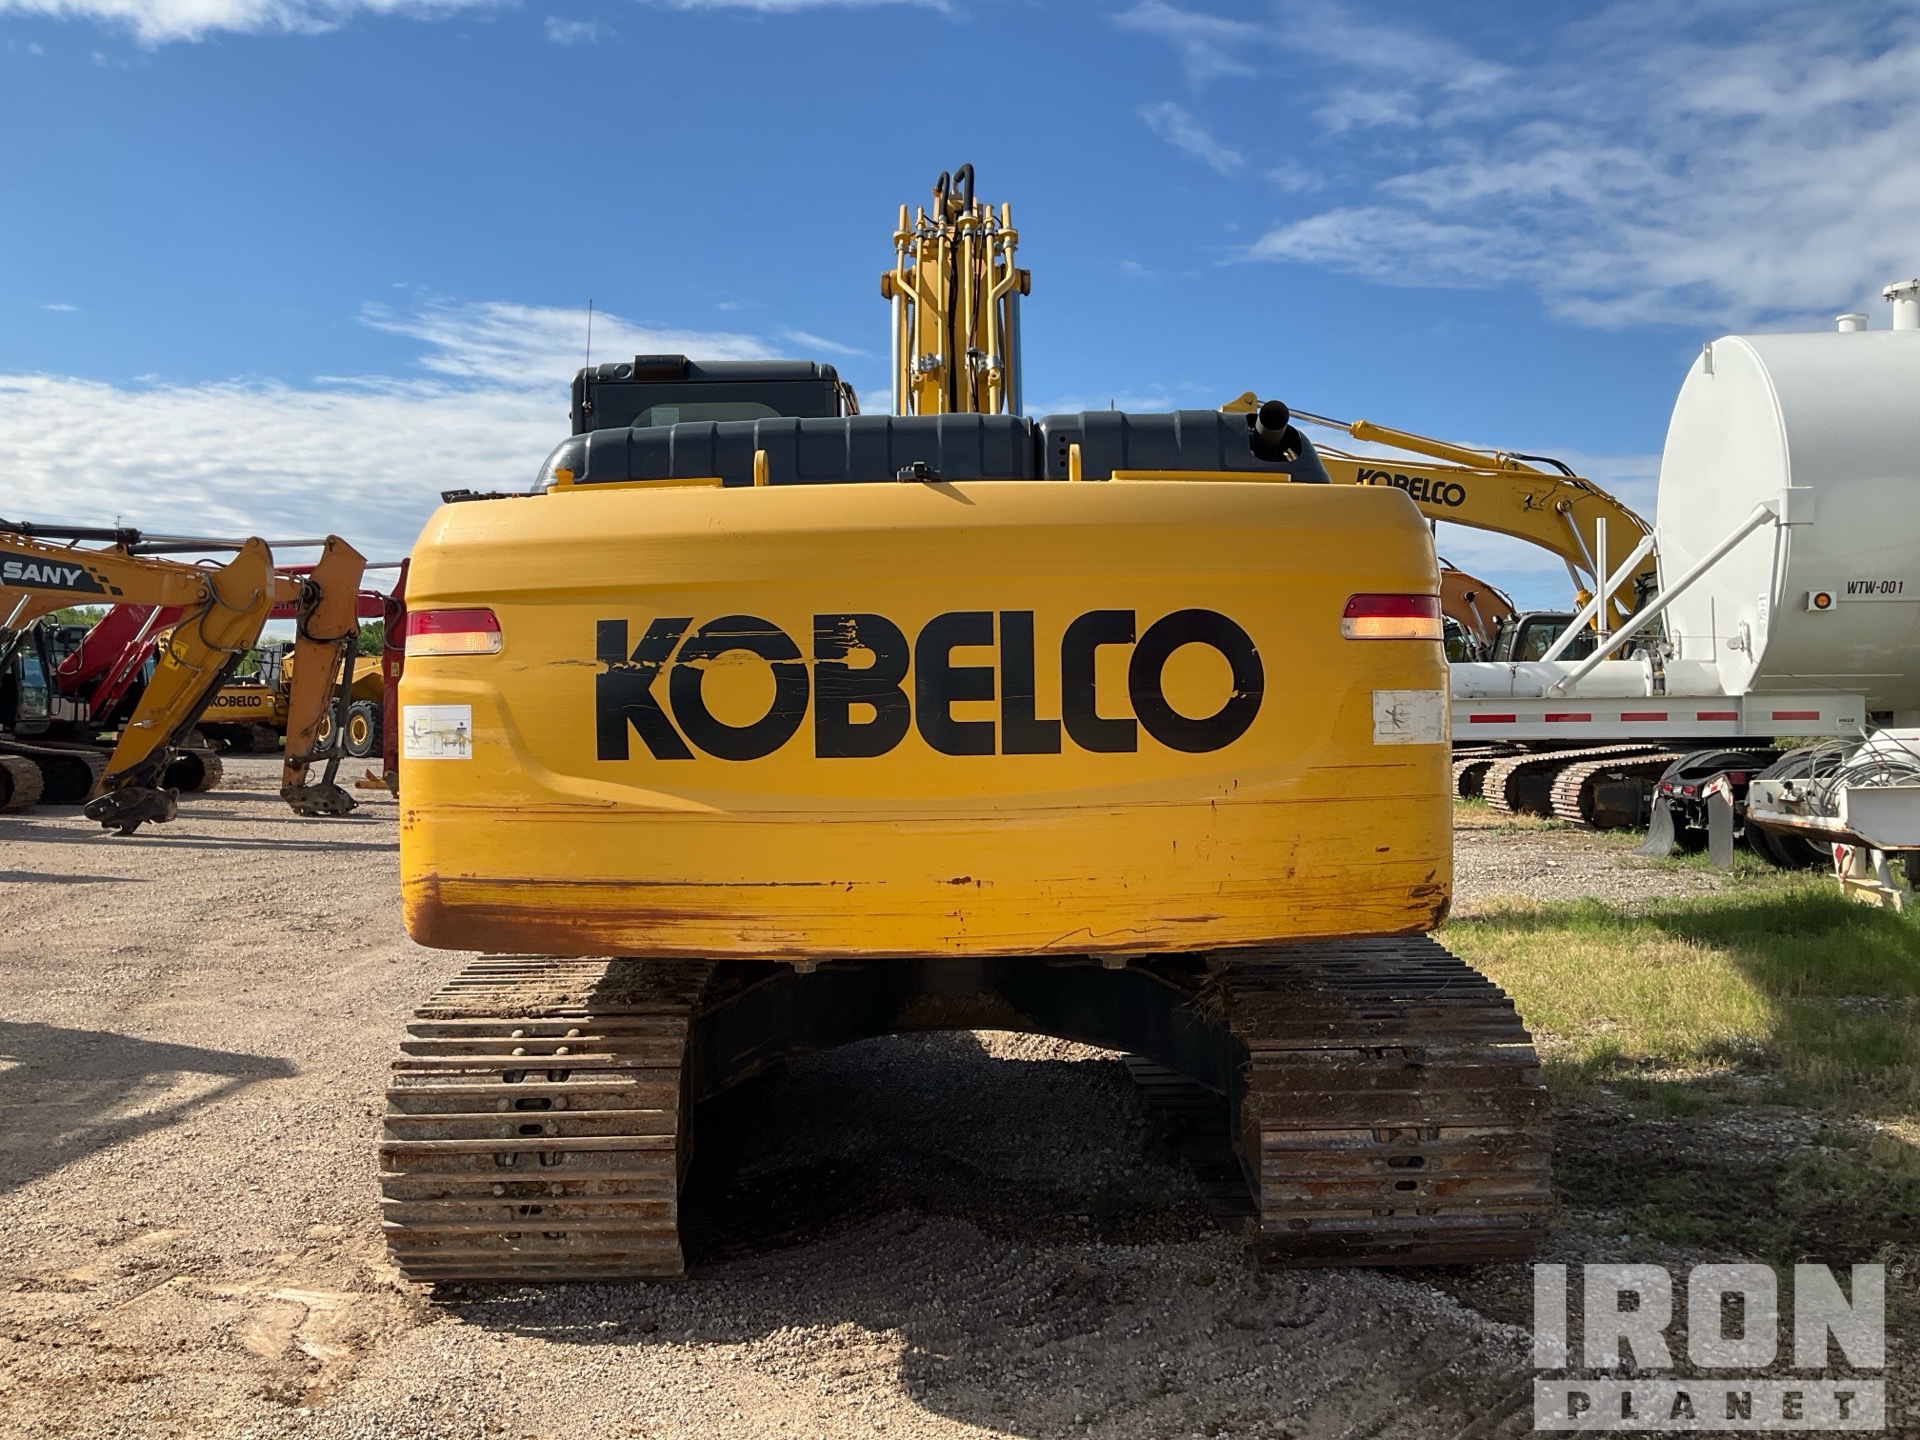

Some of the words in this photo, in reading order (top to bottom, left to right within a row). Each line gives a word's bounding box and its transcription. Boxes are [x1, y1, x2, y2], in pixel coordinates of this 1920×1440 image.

[3, 561, 83, 586] SANY
[1847, 580, 1904, 594] WTW-001
[596, 608, 1264, 761] KOBELCO
